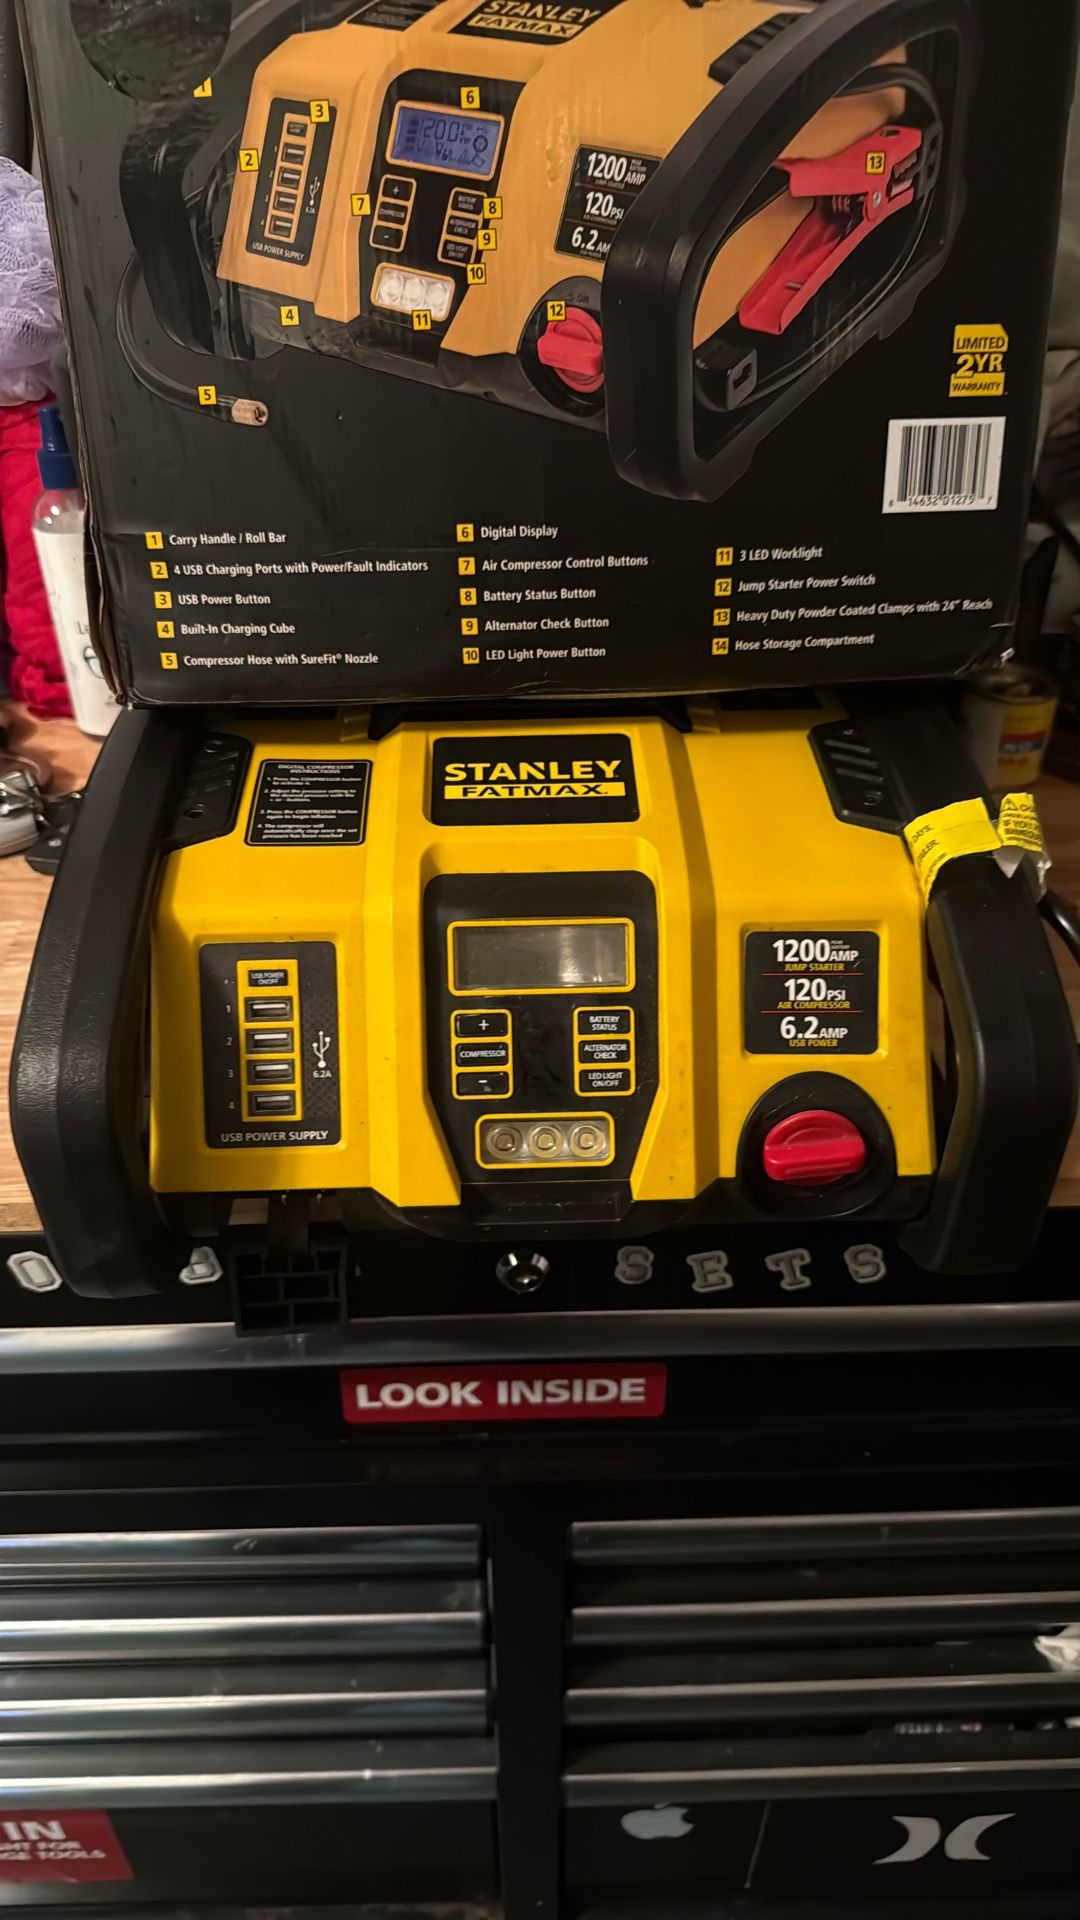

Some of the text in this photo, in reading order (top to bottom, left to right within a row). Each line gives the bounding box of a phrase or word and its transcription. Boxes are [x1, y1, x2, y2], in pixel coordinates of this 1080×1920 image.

[484, 0, 601, 23] STANLEY
[472, 16, 573, 38] FATMAX
[465, 90, 475, 104] 6
[587, 152, 627, 182] 1200
[624, 171, 647, 186] AMP
[869, 155, 883, 170] 13
[585, 191, 614, 218] 120
[611, 207, 625, 220] PSI
[571, 226, 599, 251] 6.2
[597, 242, 611, 254] AM
[252, 241, 305, 261] USB POWER SUPPLY
[469, 266, 484, 280] 10
[285, 309, 294, 322] 4
[550, 304, 564, 317] 12
[415, 313, 428, 326] 11
[956, 336, 1005, 350] LIMITED
[956, 353, 1003, 378] 2YR
[169, 534, 198, 548] Carry
[200, 532, 237, 545] Handle
[245, 532, 266, 544] Roll
[268, 532, 287, 544] Bar
[480, 525, 516, 541] Digital
[519, 524, 559, 539] Display
[718, 550, 731, 563] 11
[749, 549, 769, 561] LED
[771, 546, 824, 561] Worklight
[182, 564, 203, 576] USB
[206, 563, 253, 577] Charging
[255, 562, 283, 574] Ports
[285, 561, 309, 574] with
[311, 560, 374, 573] Power/Fault
[376, 560, 429, 572] Indicators
[482, 560, 498, 571] Air
[500, 559, 563, 573] Compressor
[565, 555, 605, 569] Control
[607, 555, 648, 567] Buttons
[717, 573, 876, 594] 12 Jump Starter Power Switch
[178, 594, 199, 605] USB
[201, 593, 233, 605] Power
[235, 593, 271, 604] Button
[483, 590, 522, 604] Battery
[524, 589, 557, 601] Status
[560, 588, 597, 599] Button
[716, 611, 729, 623] 13
[736, 610, 769, 624] Heavy
[770, 608, 796, 622] Duty
[797, 605, 838, 619] Powder
[839, 603, 876, 617] Coated
[877, 602, 916, 617] Clamps
[916, 600, 941, 613] with
[962, 598, 993, 611] Reach
[181, 623, 219, 635] Built-In
[221, 622, 267, 637] Charging
[269, 622, 296, 634] Cube
[485, 620, 537, 631] Alternator
[540, 618, 571, 630] Check
[574, 618, 610, 629] Button
[714, 634, 876, 652] 14 Hose Storage Compartment
[183, 655, 245, 668] Compressor
[247, 654, 273, 665] Hose
[275, 653, 299, 665] with
[344, 652, 379, 664] Nozzle
[465, 647, 607, 662] 10 LED Light Power Button
[444, 760, 622, 782] STANLEY
[772, 939, 860, 962] 1200 AMP
[784, 963, 845, 972] JUMP STARTER
[784, 978, 847, 1001] 120 PSI
[777, 1001, 851, 1009] AIR COMPRESSOR
[589, 1016, 620, 1024] BATTERY
[592, 1023, 618, 1031] STATUS
[780, 1016, 849, 1040] 6.2 AMP
[584, 1043, 627, 1052] ALTERNATOR
[789, 1039, 838, 1047] USB POWER
[459, 1049, 506, 1058] COMPRESSOR
[593, 1051, 617, 1060] CHECK
[312, 1070, 332, 1078] 6.2A
[588, 1071, 624, 1080] LED LIGHT
[592, 1080, 620, 1088] ON/OFF
[221, 1130, 329, 1143] USB POWER SUPPLY
[355, 1377, 647, 1409] LOOK INSIDE
[2, 1820, 67, 1841] IN
[37, 1840, 82, 1850] FOR
[37, 1849, 107, 1860] TOOLS
